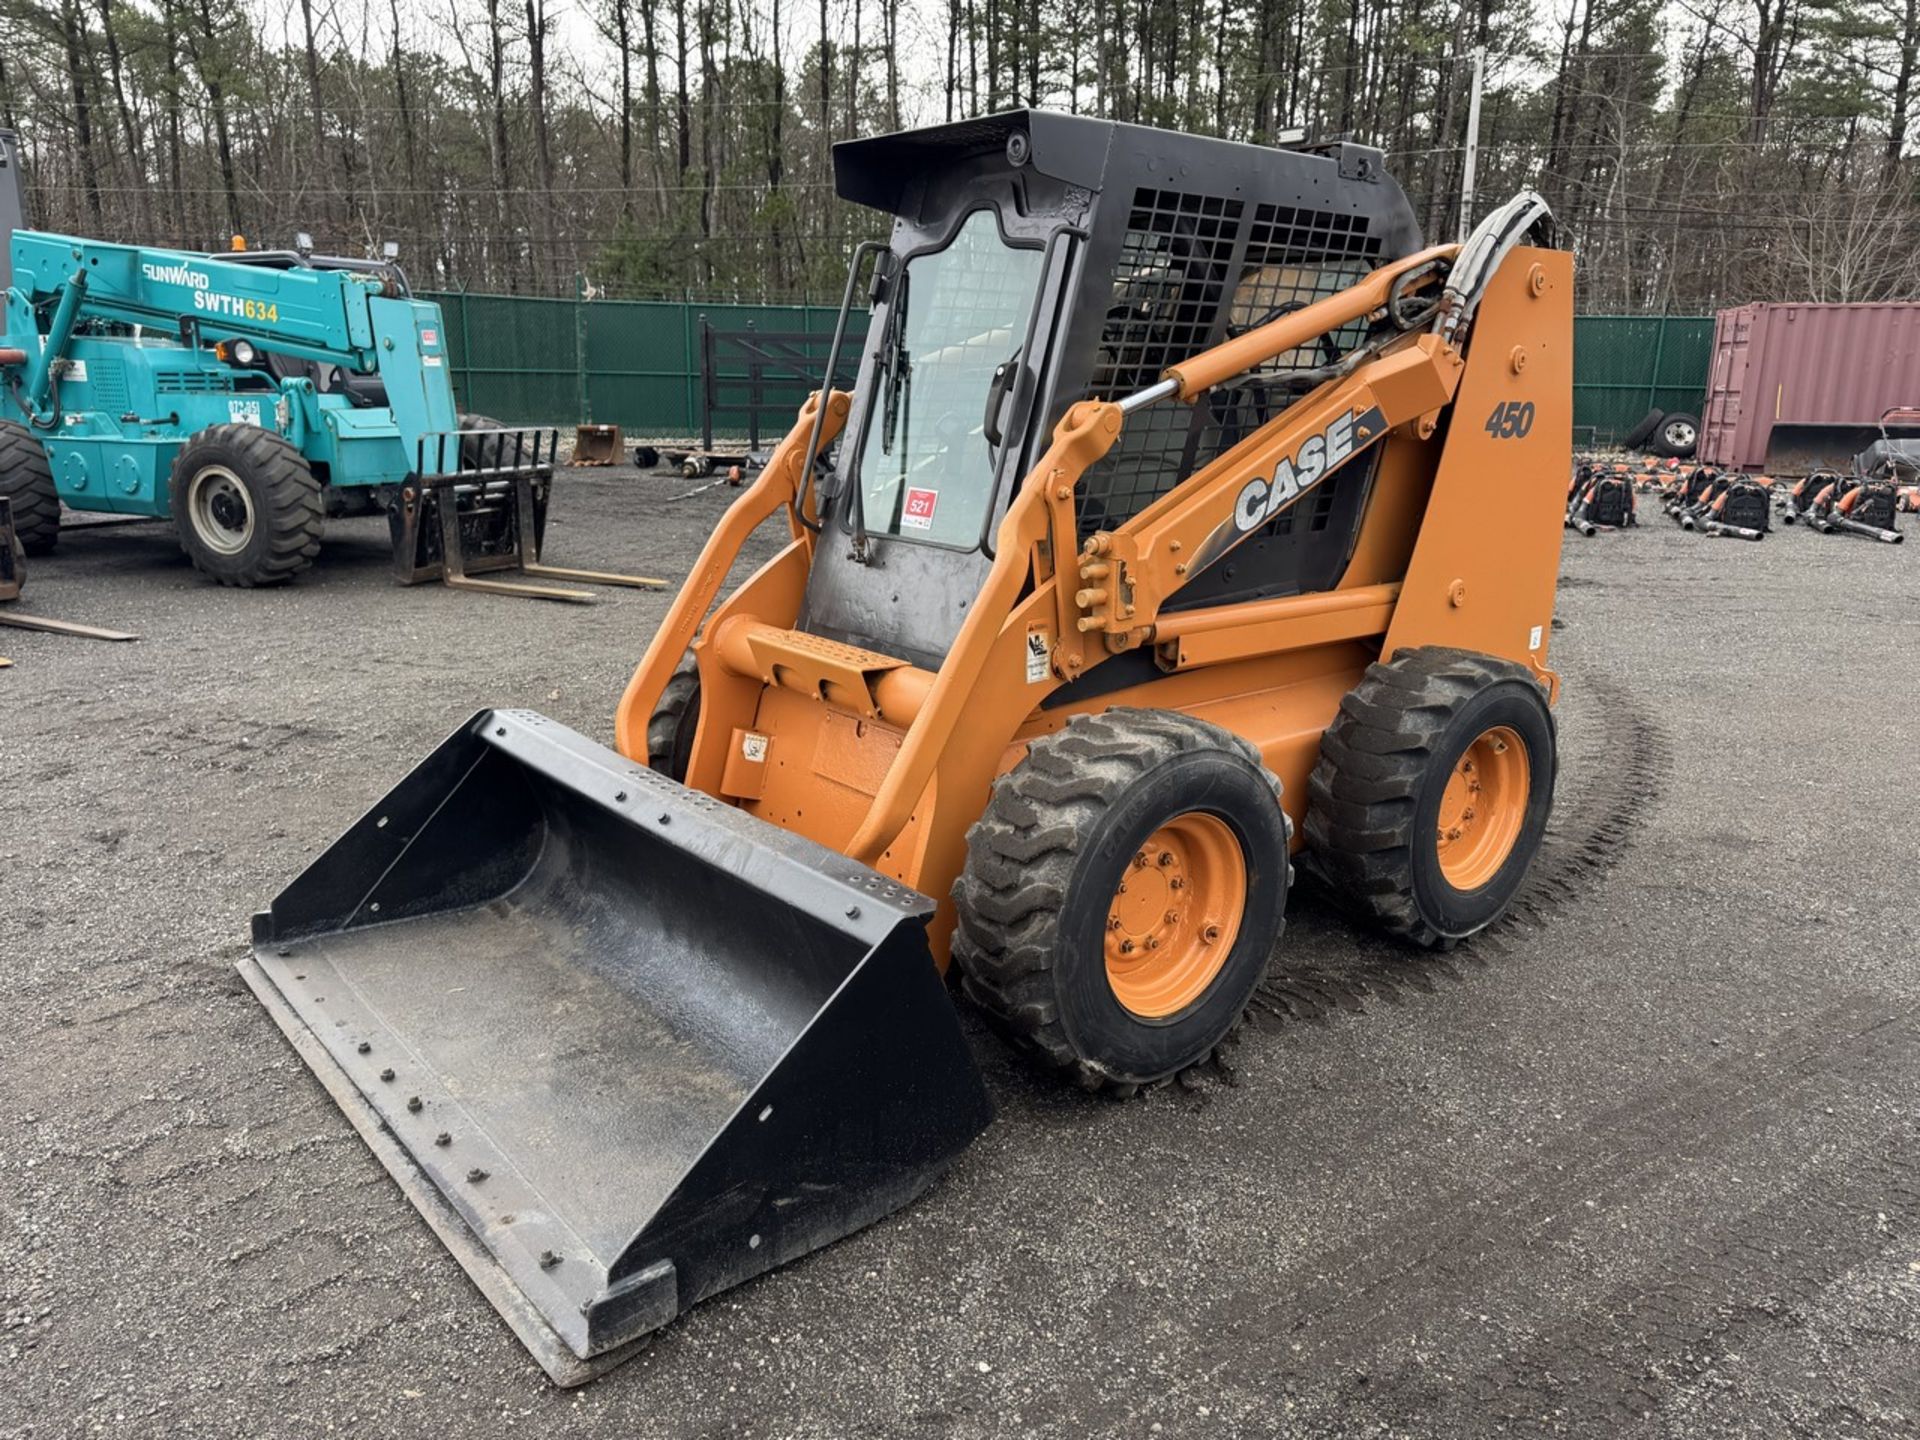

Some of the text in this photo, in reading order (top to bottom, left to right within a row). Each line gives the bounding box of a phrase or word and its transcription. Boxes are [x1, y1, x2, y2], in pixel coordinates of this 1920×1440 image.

[142, 261, 209, 289] SUNWARD
[194, 290, 278, 322] SWTH634
[1485, 401, 1535, 439] 450
[1234, 408, 1353, 532] CASE
[910, 499, 929, 514] 521
